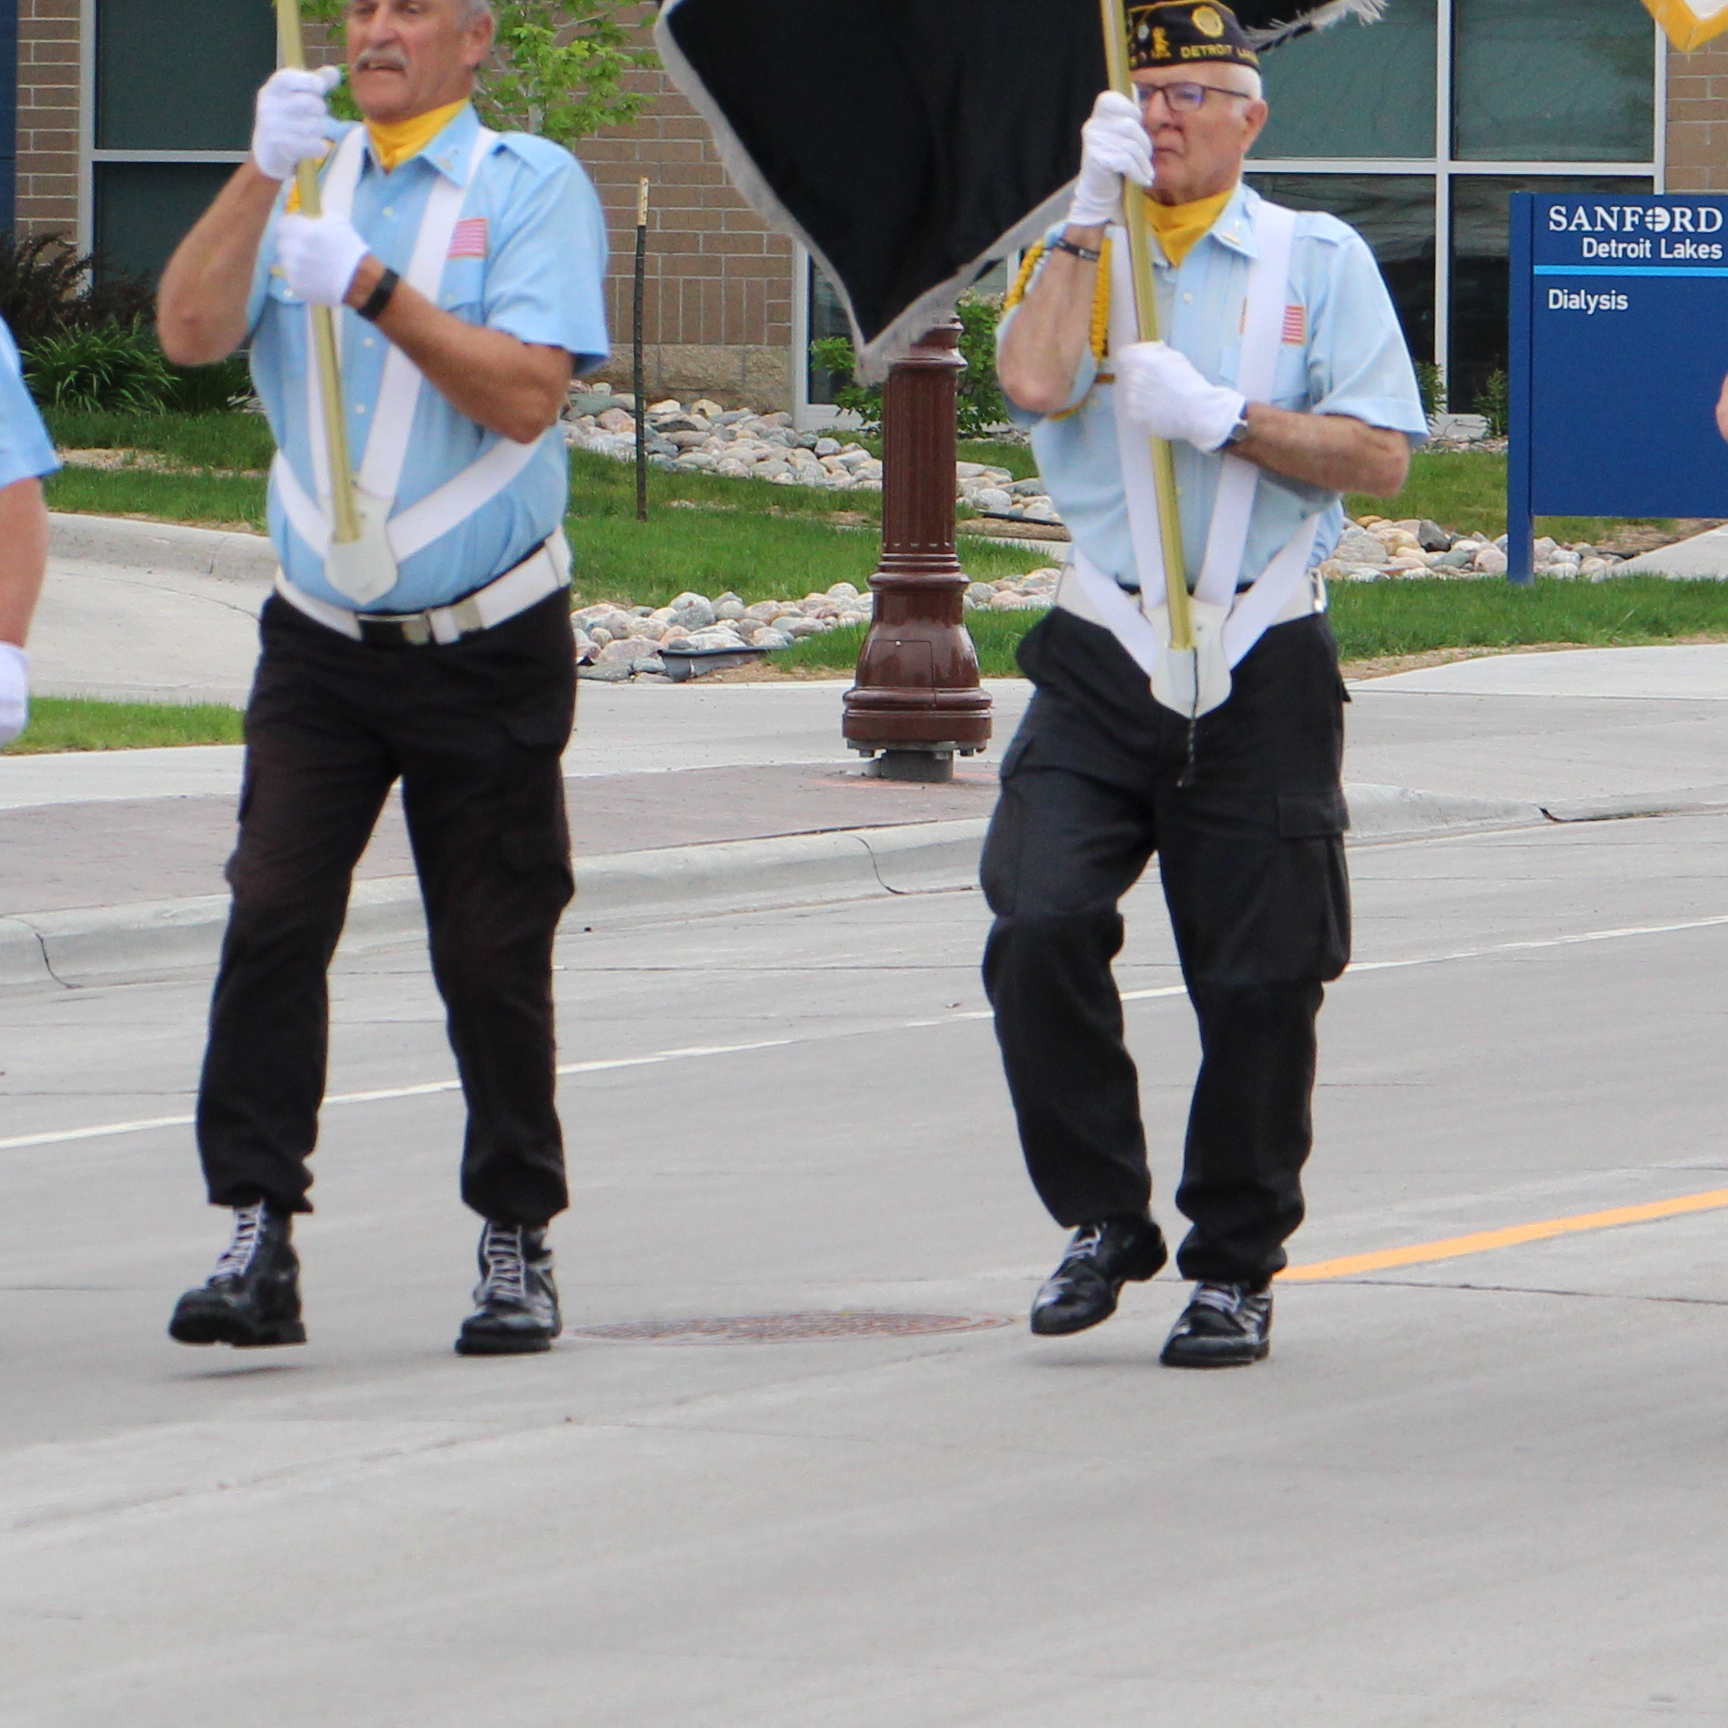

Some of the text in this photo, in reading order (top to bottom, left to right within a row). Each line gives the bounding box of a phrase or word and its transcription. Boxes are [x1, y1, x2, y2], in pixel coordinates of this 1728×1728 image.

[1548, 205, 1723, 233] SANFORD
[1582, 238, 1723, 260] Detroit Lakes
[1548, 289, 1629, 314] Dialysis
